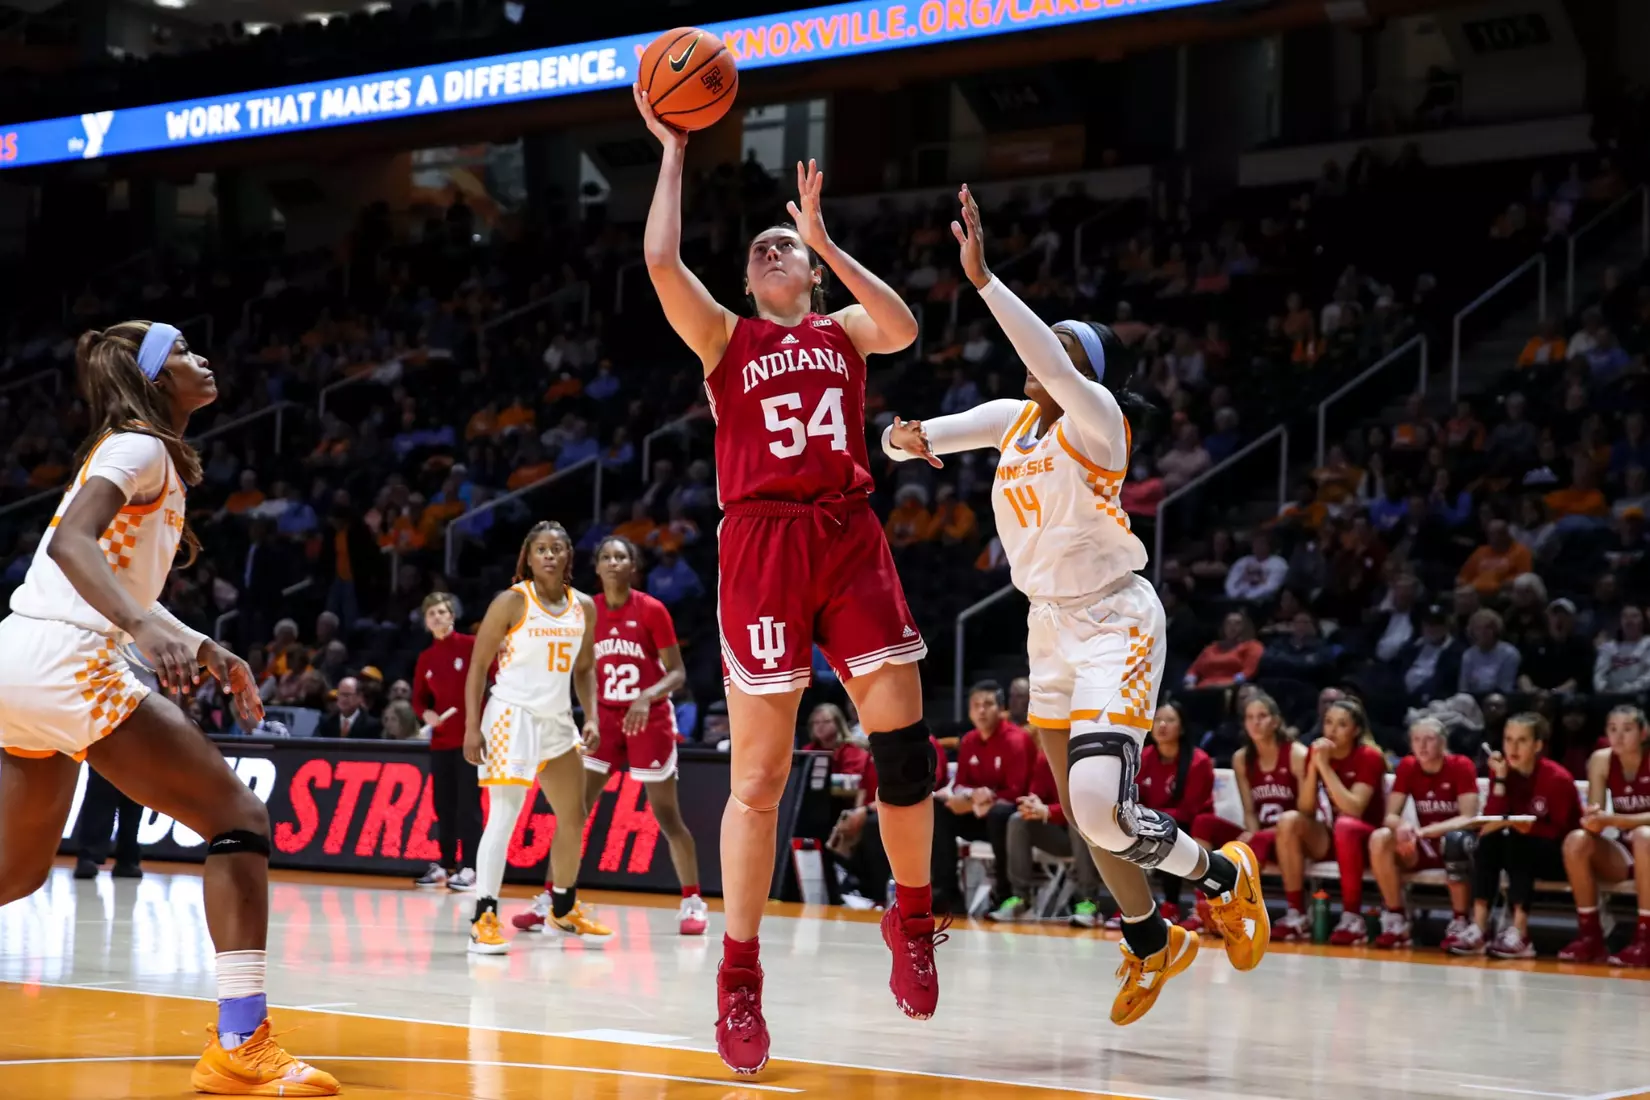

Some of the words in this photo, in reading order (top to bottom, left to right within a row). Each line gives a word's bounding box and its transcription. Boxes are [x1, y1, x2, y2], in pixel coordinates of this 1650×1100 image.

[165, 101, 242, 140] WORK
[246, 91, 317, 129] THAT
[320, 77, 412, 120] MAKES
[415, 74, 438, 107] A
[443, 48, 627, 103] DIFFERENCE.
[81, 110, 114, 159] Y
[742, 348, 849, 394] INDIANA
[760, 387, 848, 459] 54
[1003, 484, 1041, 528] 14
[547, 641, 573, 672] 15
[603, 663, 641, 701] 22
